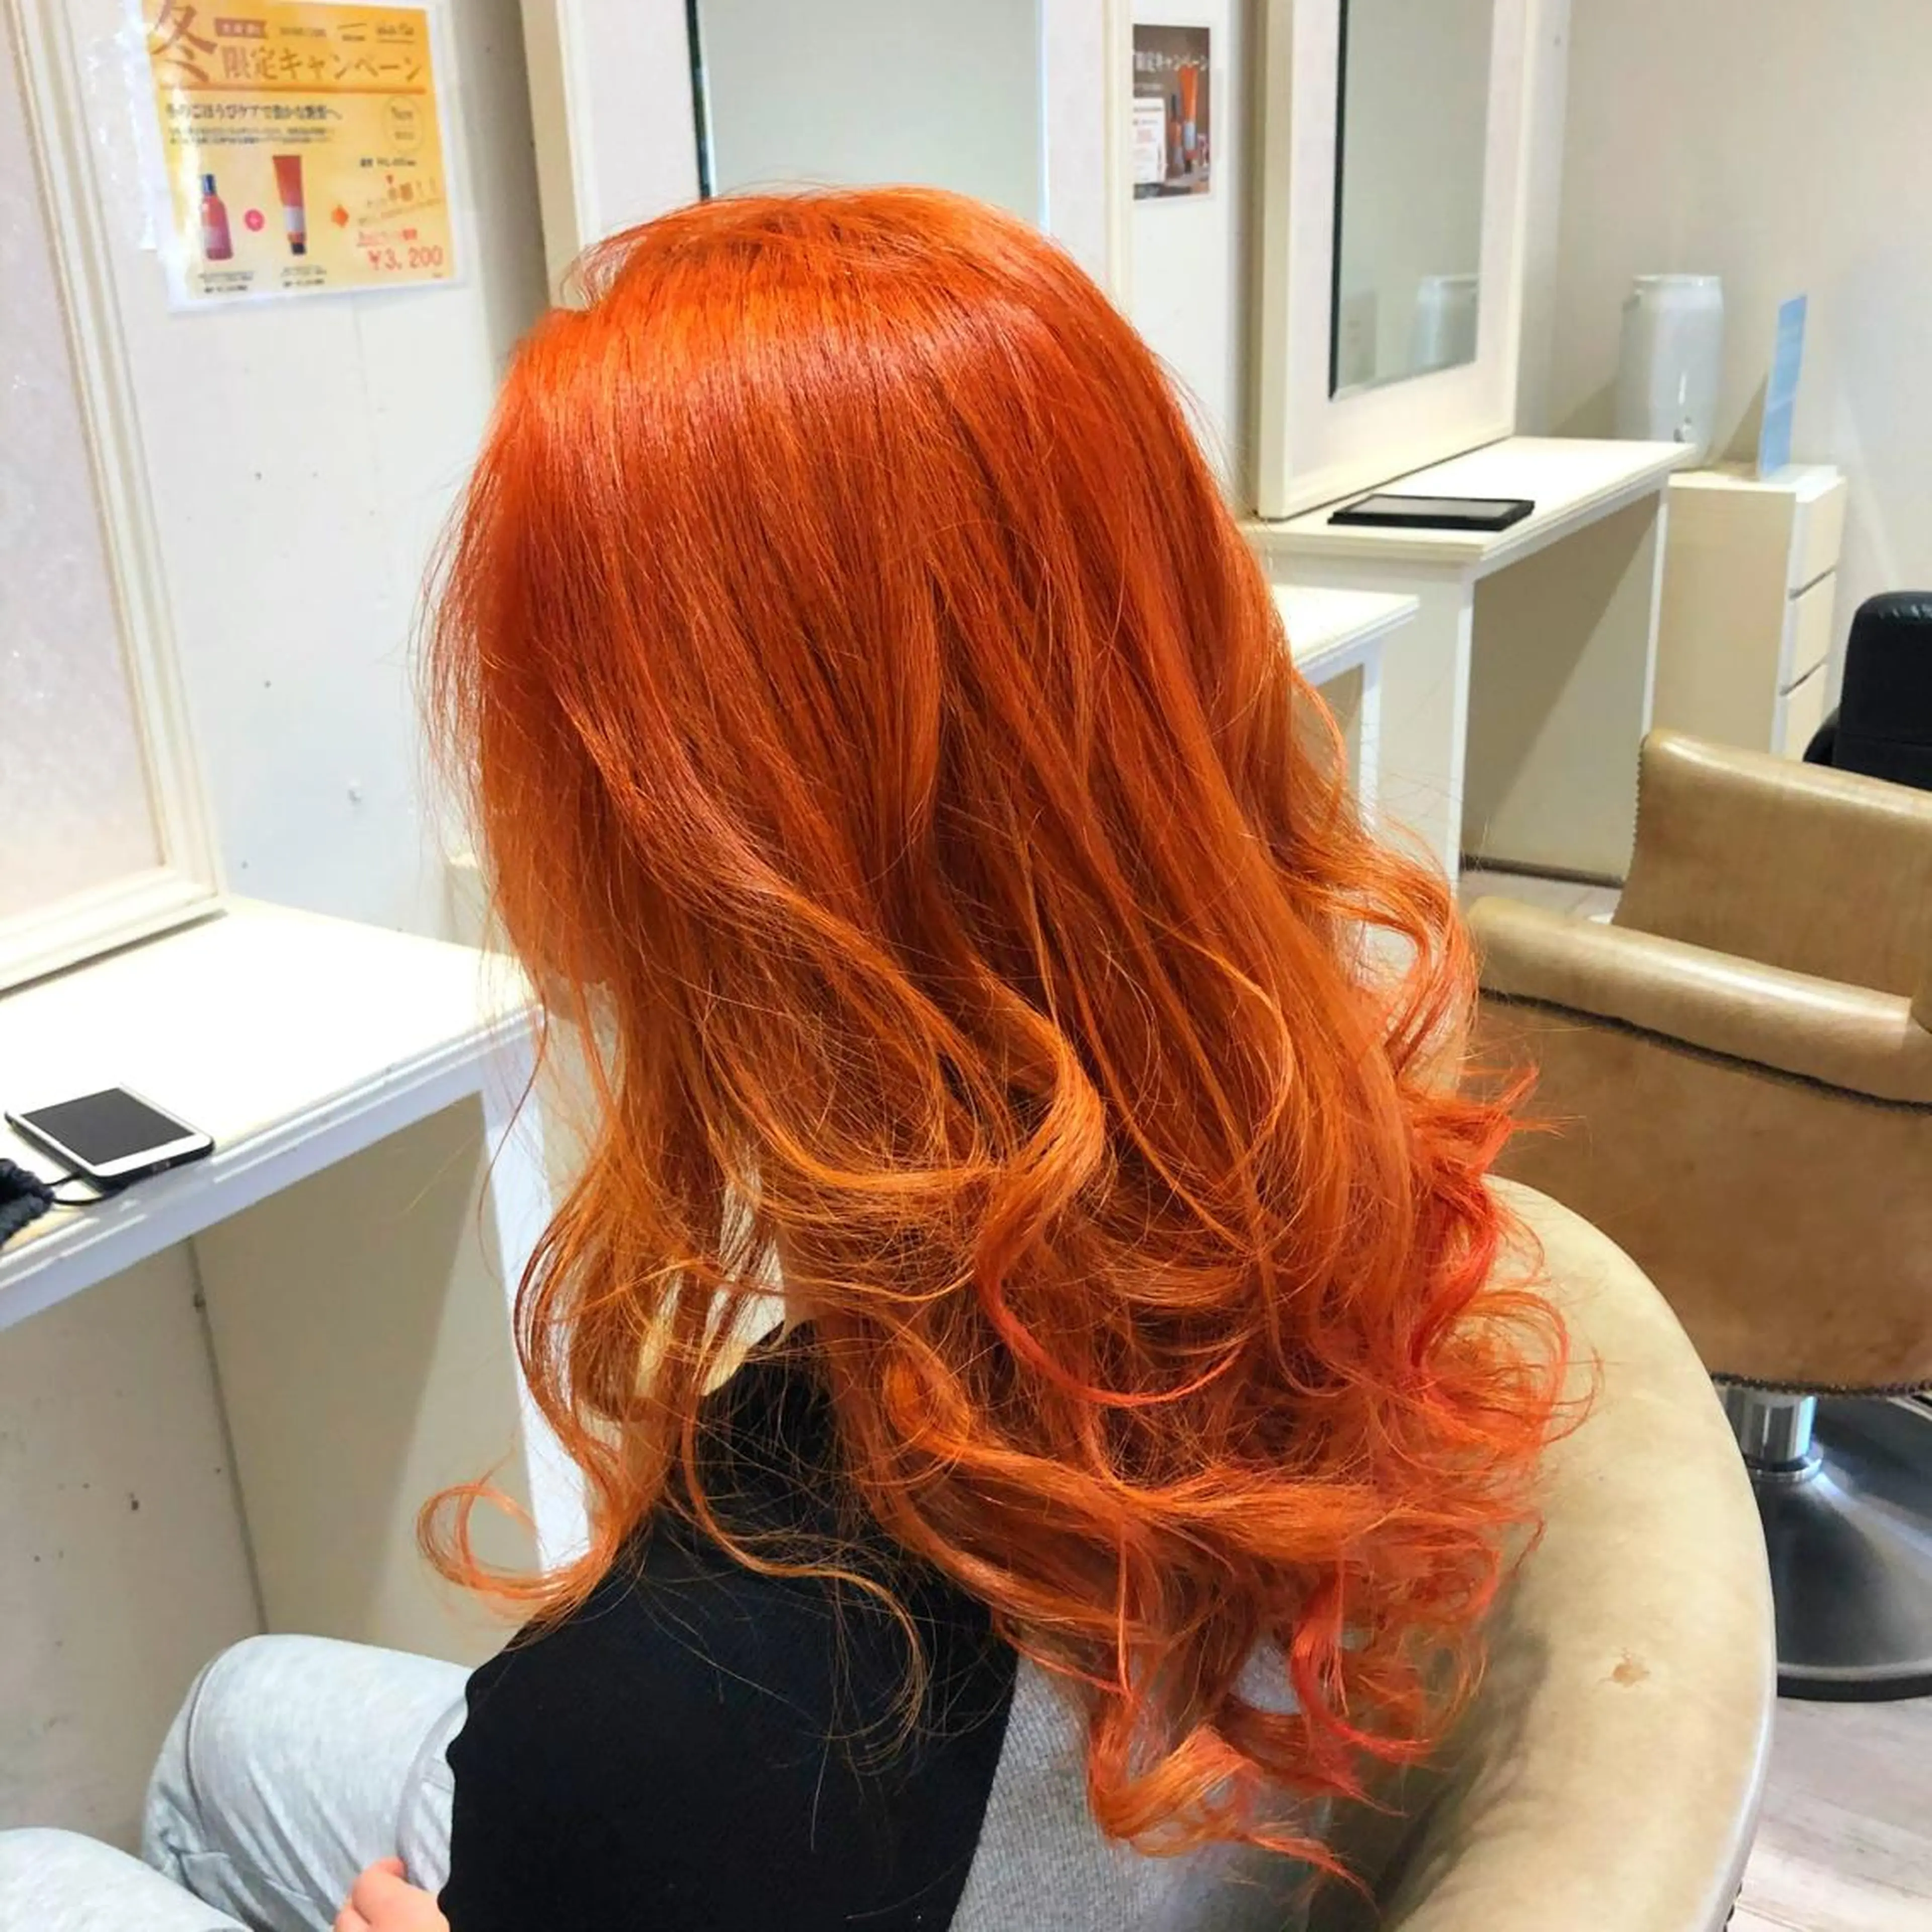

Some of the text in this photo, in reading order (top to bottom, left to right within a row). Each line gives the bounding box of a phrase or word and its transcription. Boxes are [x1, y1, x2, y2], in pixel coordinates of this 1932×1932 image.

[150, 0, 218, 83] 冬
[221, 46, 423, 82] 限定キャンペーン
